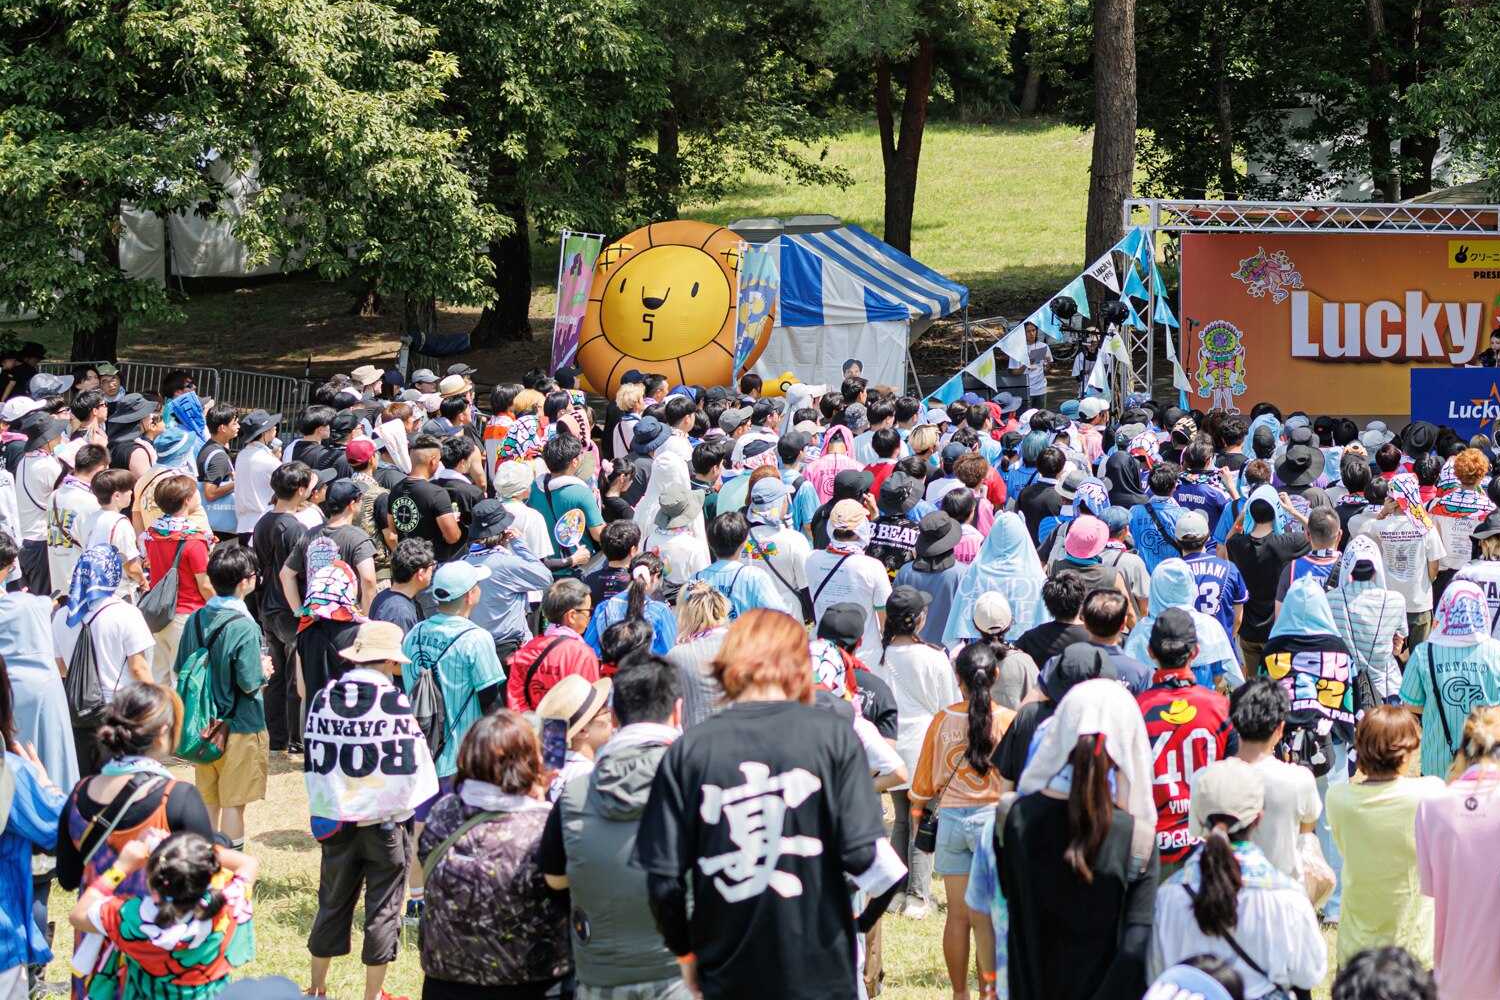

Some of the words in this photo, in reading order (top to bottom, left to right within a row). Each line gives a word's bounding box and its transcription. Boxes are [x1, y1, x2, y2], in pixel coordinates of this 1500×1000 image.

[1291, 290, 1482, 364] Lucky
[879, 523, 921, 546] BEAV
[1190, 562, 1226, 579] UNAMI
[1435, 661, 1489, 674] NANAKO
[317, 717, 388, 737] JAPAN
[698, 761, 824, 904] 宴
